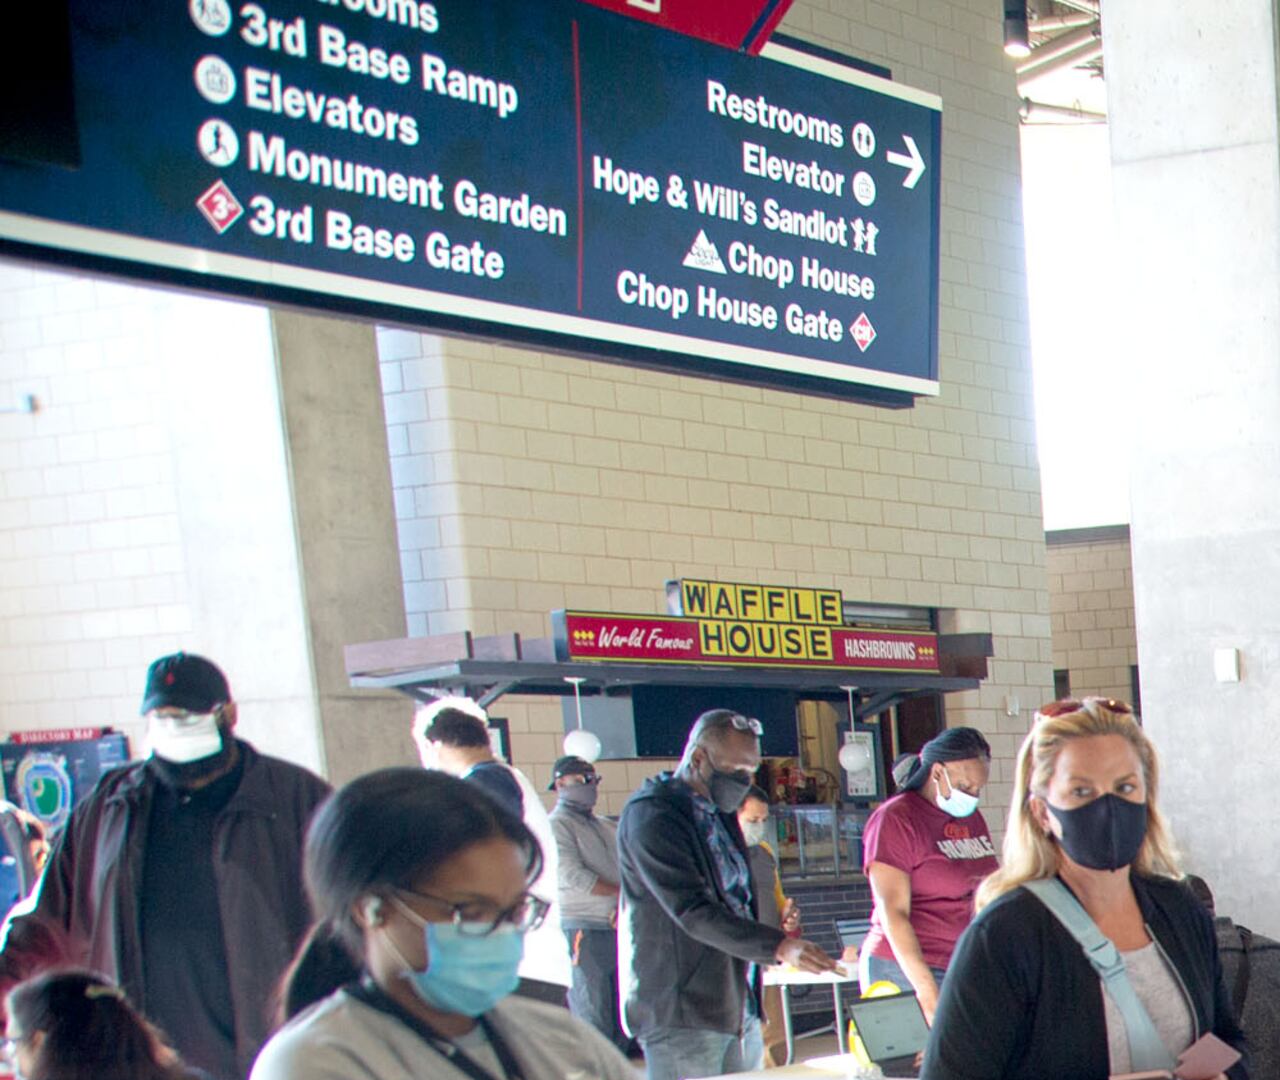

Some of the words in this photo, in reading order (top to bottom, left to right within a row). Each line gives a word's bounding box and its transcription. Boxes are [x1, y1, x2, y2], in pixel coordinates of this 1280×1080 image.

[240, 5, 307, 57] 3rd
[319, 25, 411, 84] Base
[422, 54, 518, 117] Ramp
[245, 68, 420, 145] Elevators
[707, 80, 844, 148] Restrooms
[248, 132, 444, 210] Monument
[454, 180, 567, 236] Garden
[593, 156, 660, 204] Hope
[666, 175, 688, 209] &
[694, 181, 758, 225] Will's
[764, 199, 848, 247] Sandlot
[743, 142, 845, 197] Elevator
[249, 196, 312, 243] 3rd
[327, 210, 415, 262] Base
[426, 232, 504, 279] Gate
[728, 242, 794, 289] Chop
[802, 257, 875, 301] House
[617, 271, 689, 319] Chop
[698, 286, 778, 330] House
[785, 304, 844, 342] Gate
[685, 584, 838, 621] WAFFLE
[598, 626, 643, 649] World
[649, 628, 694, 650] Famous
[702, 624, 829, 656] HOUSE
[844, 638, 916, 660] HASHBROWNS
